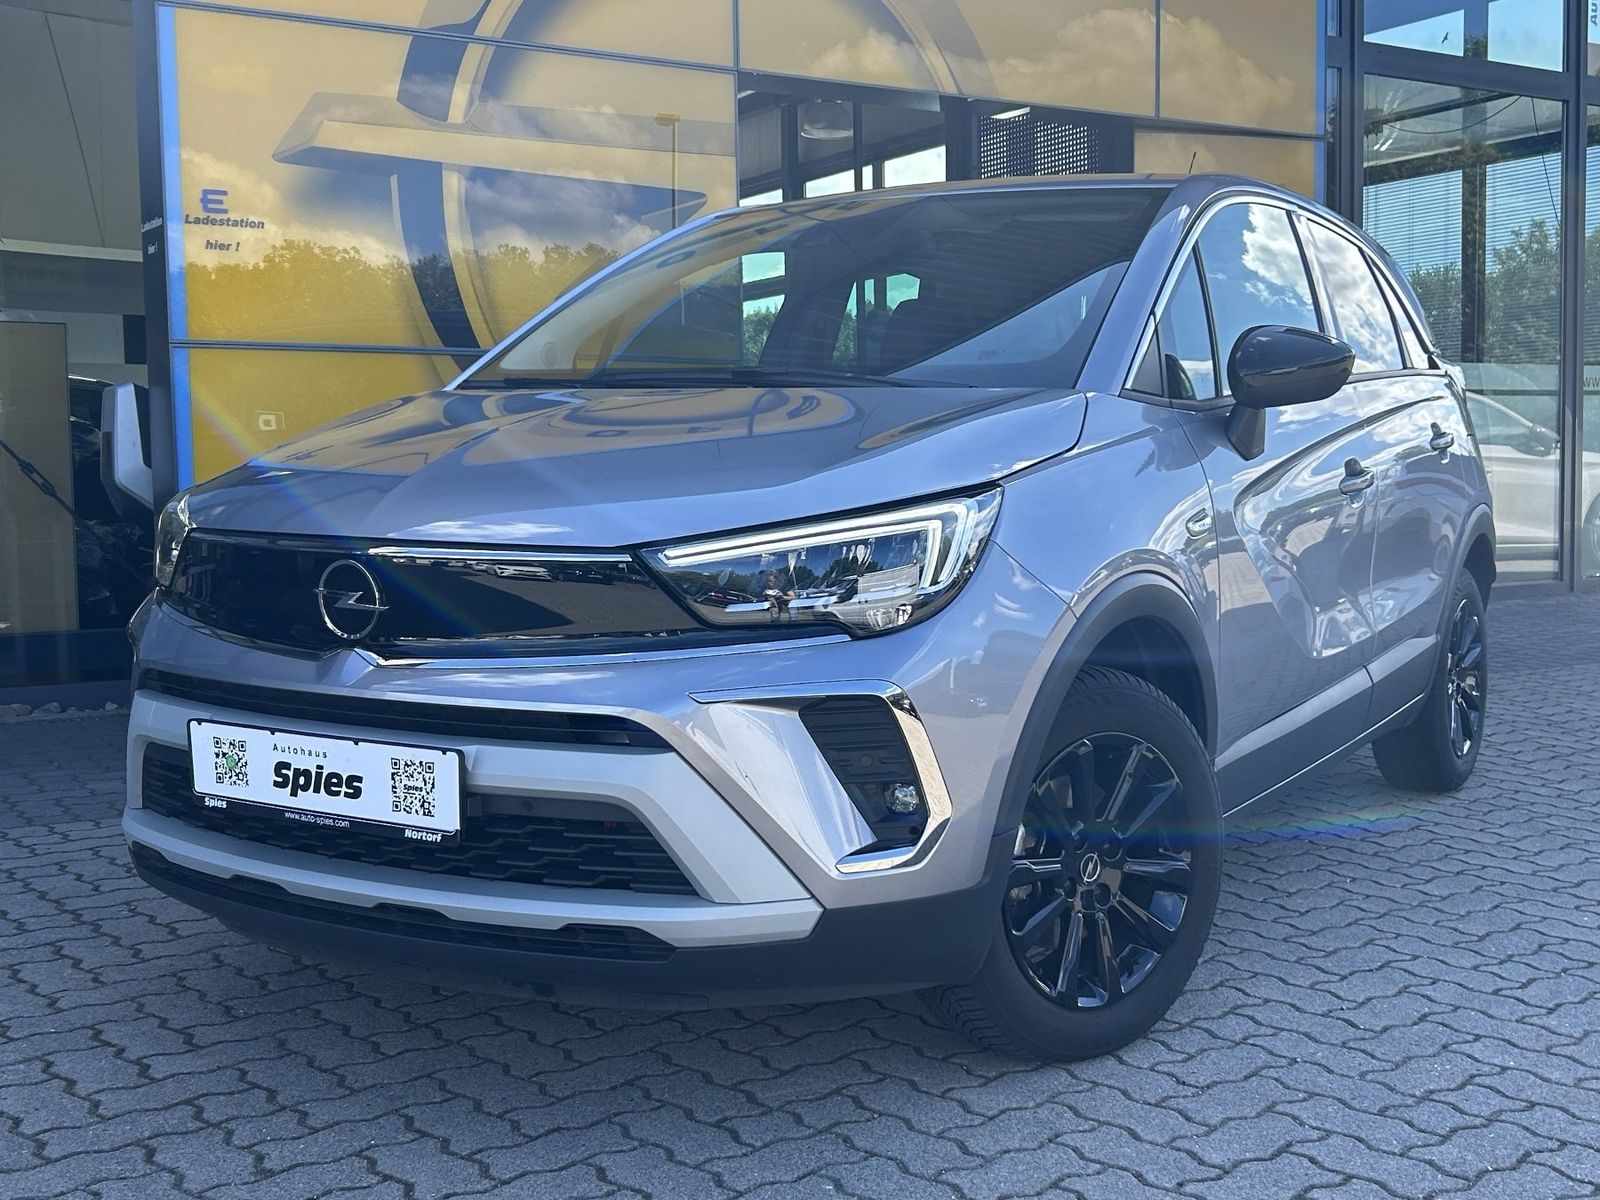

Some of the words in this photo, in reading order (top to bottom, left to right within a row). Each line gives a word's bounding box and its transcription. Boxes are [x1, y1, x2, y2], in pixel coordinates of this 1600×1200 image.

[200, 188, 229, 214] E
[184, 213, 265, 230] Ladestation
[204, 239, 232, 251] hier
[272, 743, 328, 759] Autohaus
[272, 760, 364, 800] Spies
[403, 783, 424, 793] Spies
[204, 796, 228, 809] Spies
[284, 811, 350, 828] www.auto-spies.com
[404, 828, 442, 843] Nortorf
